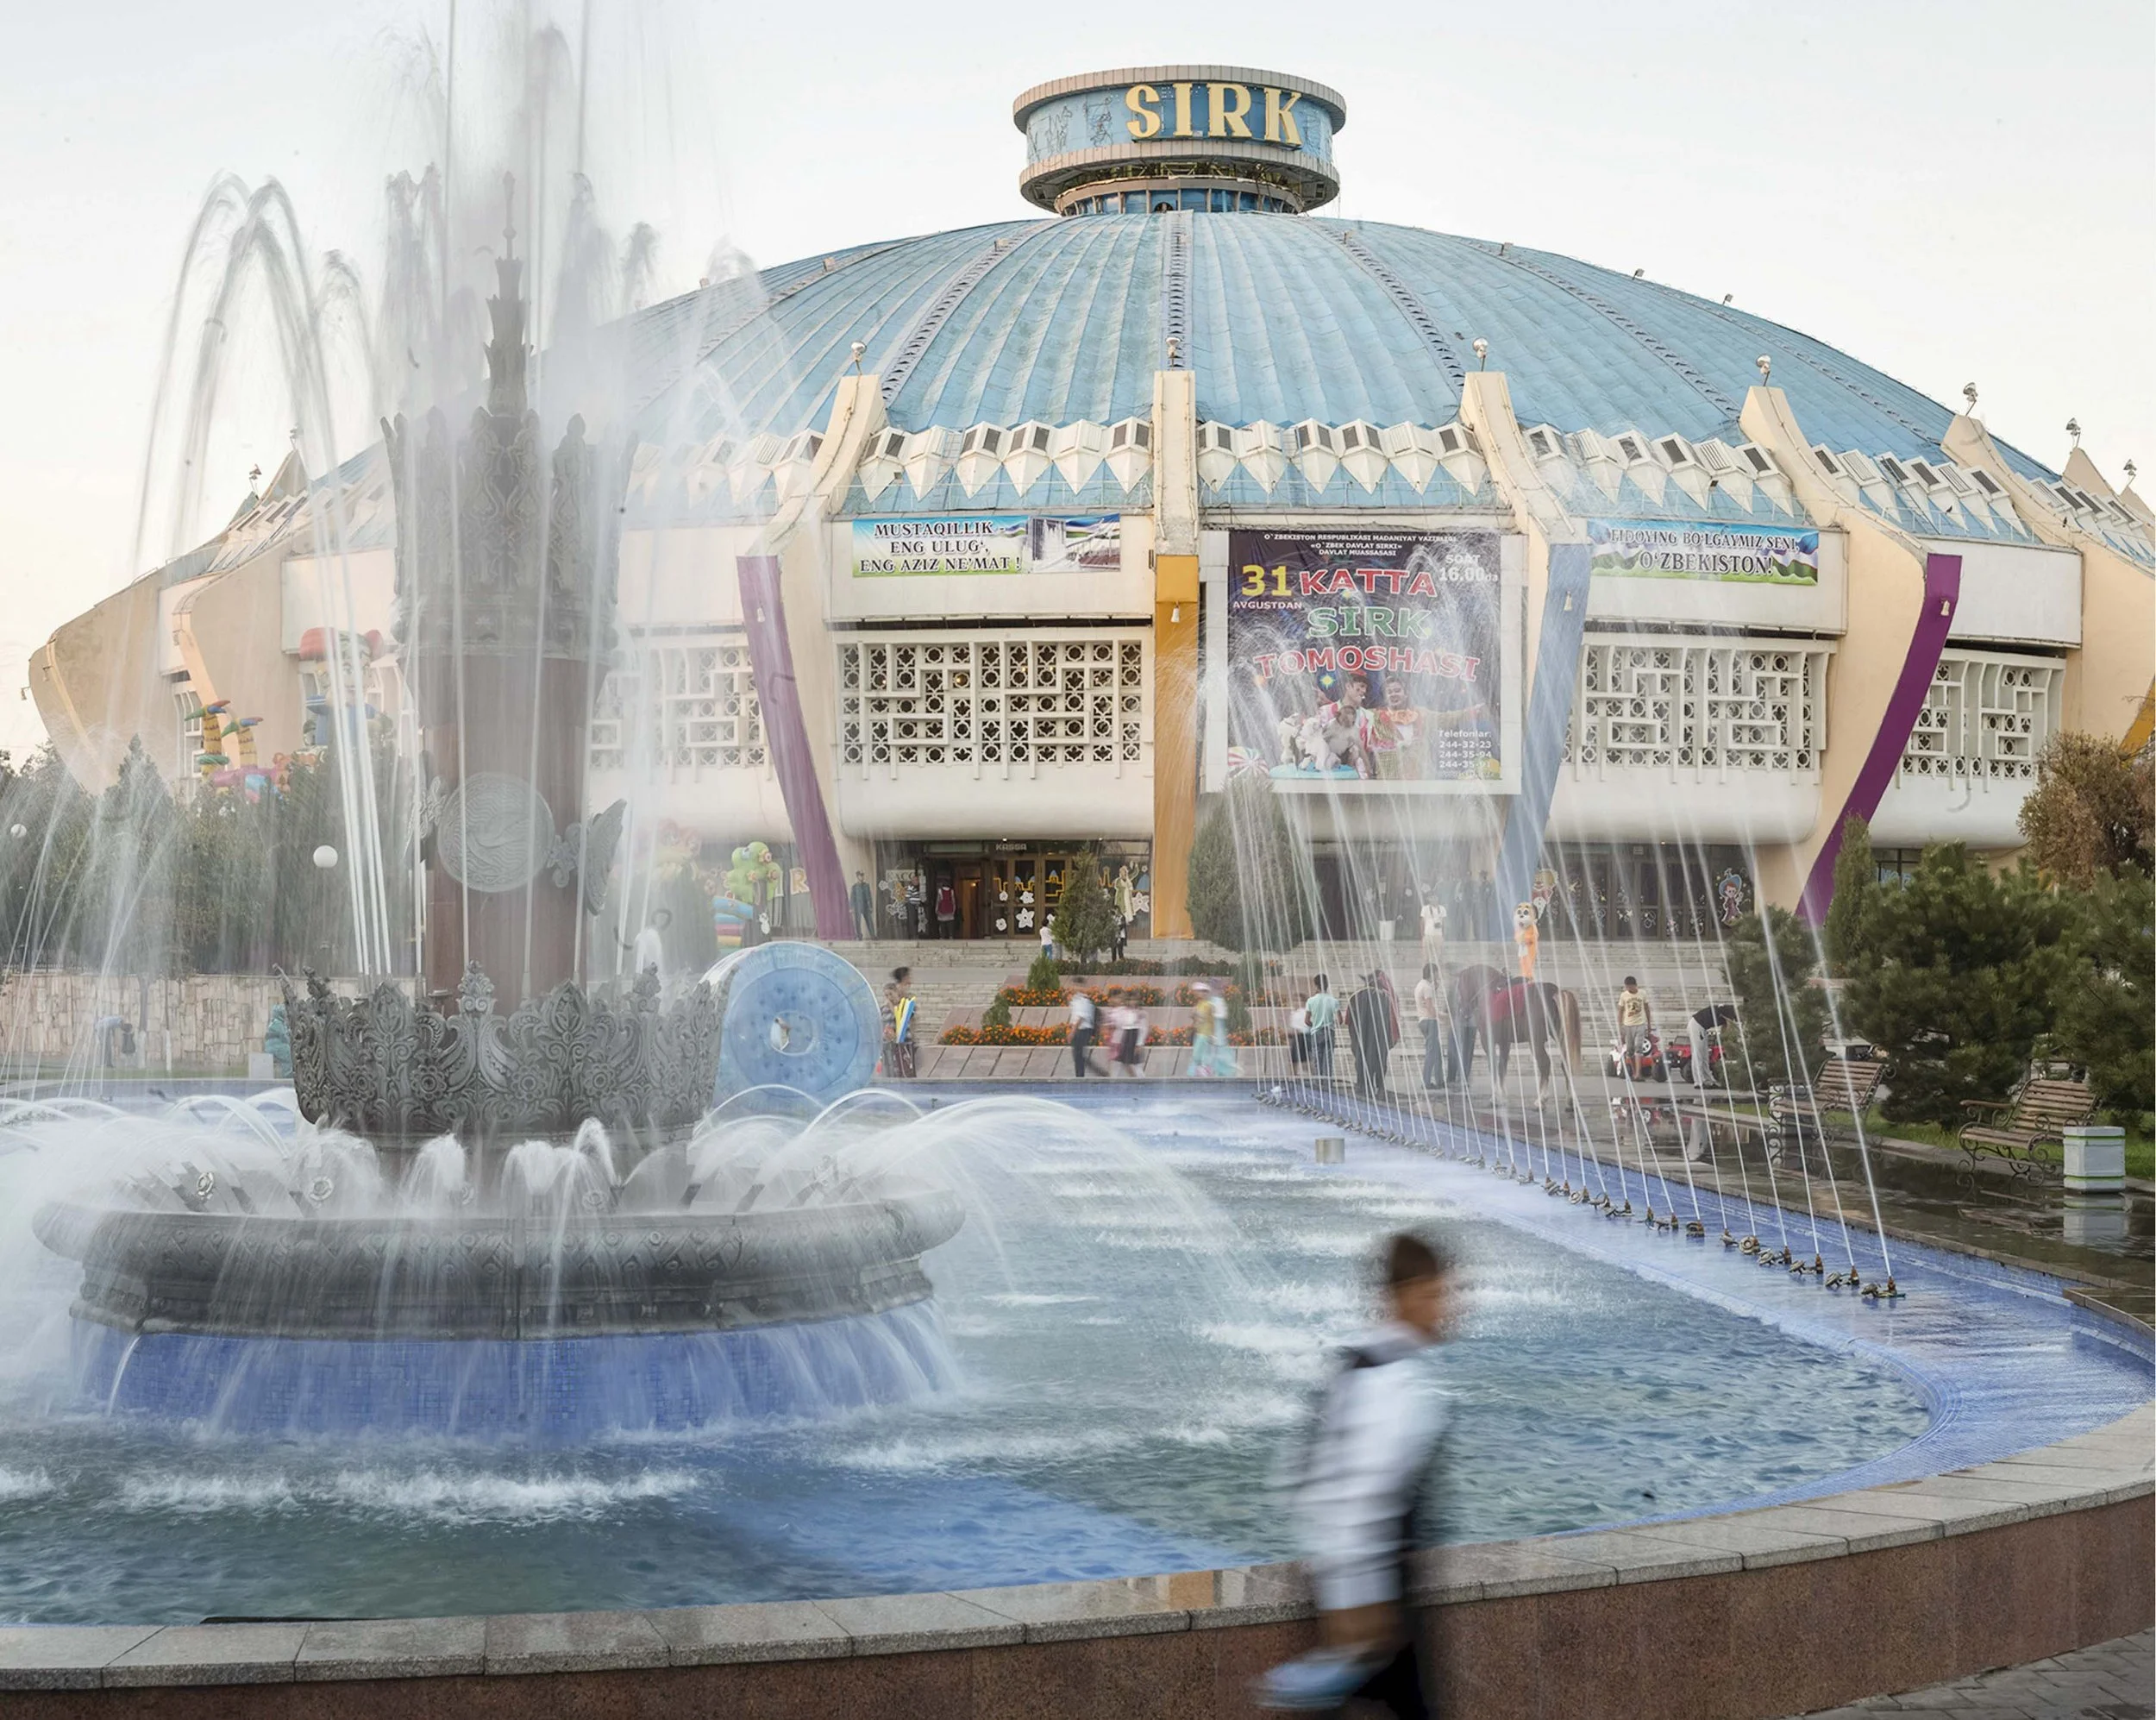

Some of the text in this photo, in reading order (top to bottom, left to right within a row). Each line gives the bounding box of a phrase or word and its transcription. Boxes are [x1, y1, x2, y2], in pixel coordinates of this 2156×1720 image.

[1125, 83, 1303, 146] SIRK
[874, 522, 993, 537] MUSTAQILLIK
[891, 541, 924, 554] ENG
[861, 559, 893, 572] ENG
[900, 558, 938, 571] AZIZ
[1241, 564, 1292, 597] 31
[1300, 568, 1438, 597] KATTA
[1232, 601, 1302, 610] AVGUSTDAN
[1307, 606, 1432, 638] SIRK
[1255, 646, 1480, 681] TOMOSHASI
